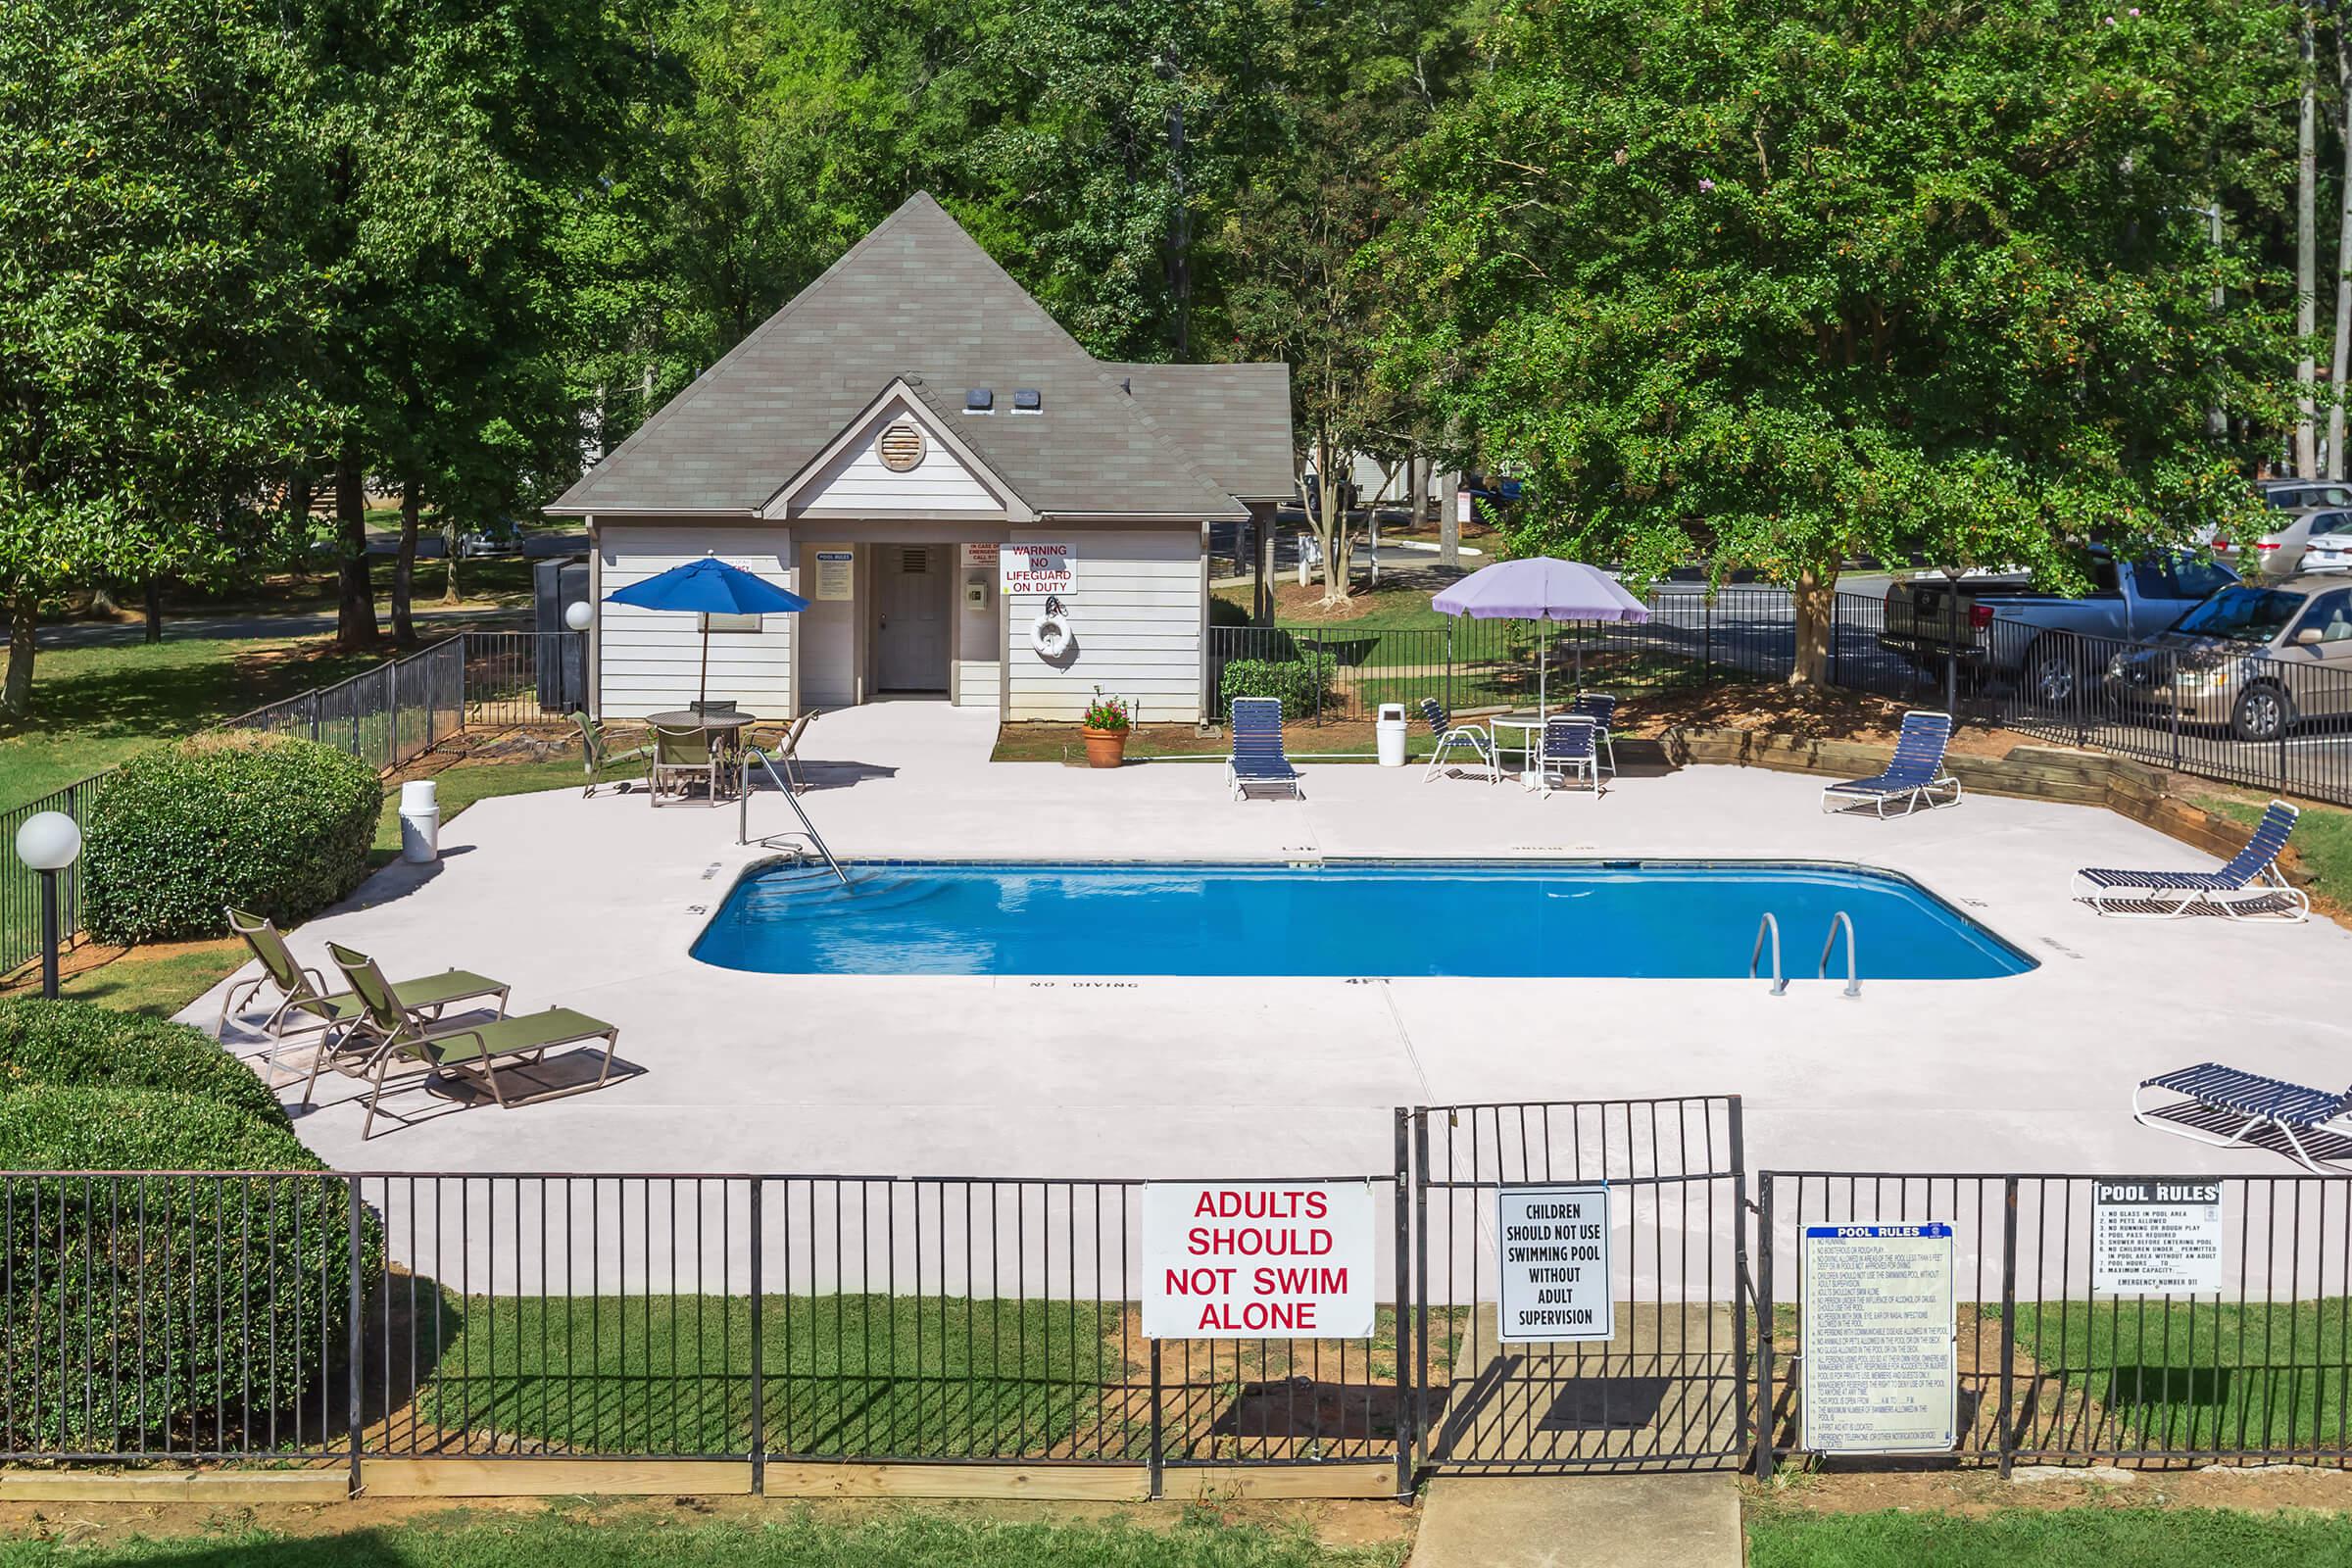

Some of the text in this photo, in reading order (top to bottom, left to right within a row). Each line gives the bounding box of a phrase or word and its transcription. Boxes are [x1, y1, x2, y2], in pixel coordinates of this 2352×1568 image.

[1012, 546, 1066, 555] WARNING
[1031, 558, 1048, 567] NO
[1007, 571, 1071, 580] LIFEGUARD
[1013, 583, 1066, 592] ON DUTY
[2101, 1186, 2217, 1200] POOL RULES
[1194, 1191, 1327, 1218] ADULTS
[1526, 1204, 1581, 1219] CHILDREN
[1506, 1225, 1600, 1241] SHOULD NOT USE
[1838, 1228, 1920, 1237] POOL RULES
[1188, 1228, 1333, 1255] SHOULD
[1508, 1247, 1600, 1262] SWIMMING POOL
[1165, 1268, 1348, 1296] NOT SWIM
[1529, 1268, 1580, 1283] WITHOUT
[1538, 1289, 1572, 1304] ADULT
[1199, 1302, 1316, 1330] ALONE
[1519, 1310, 1592, 1326] SUPERVISION
